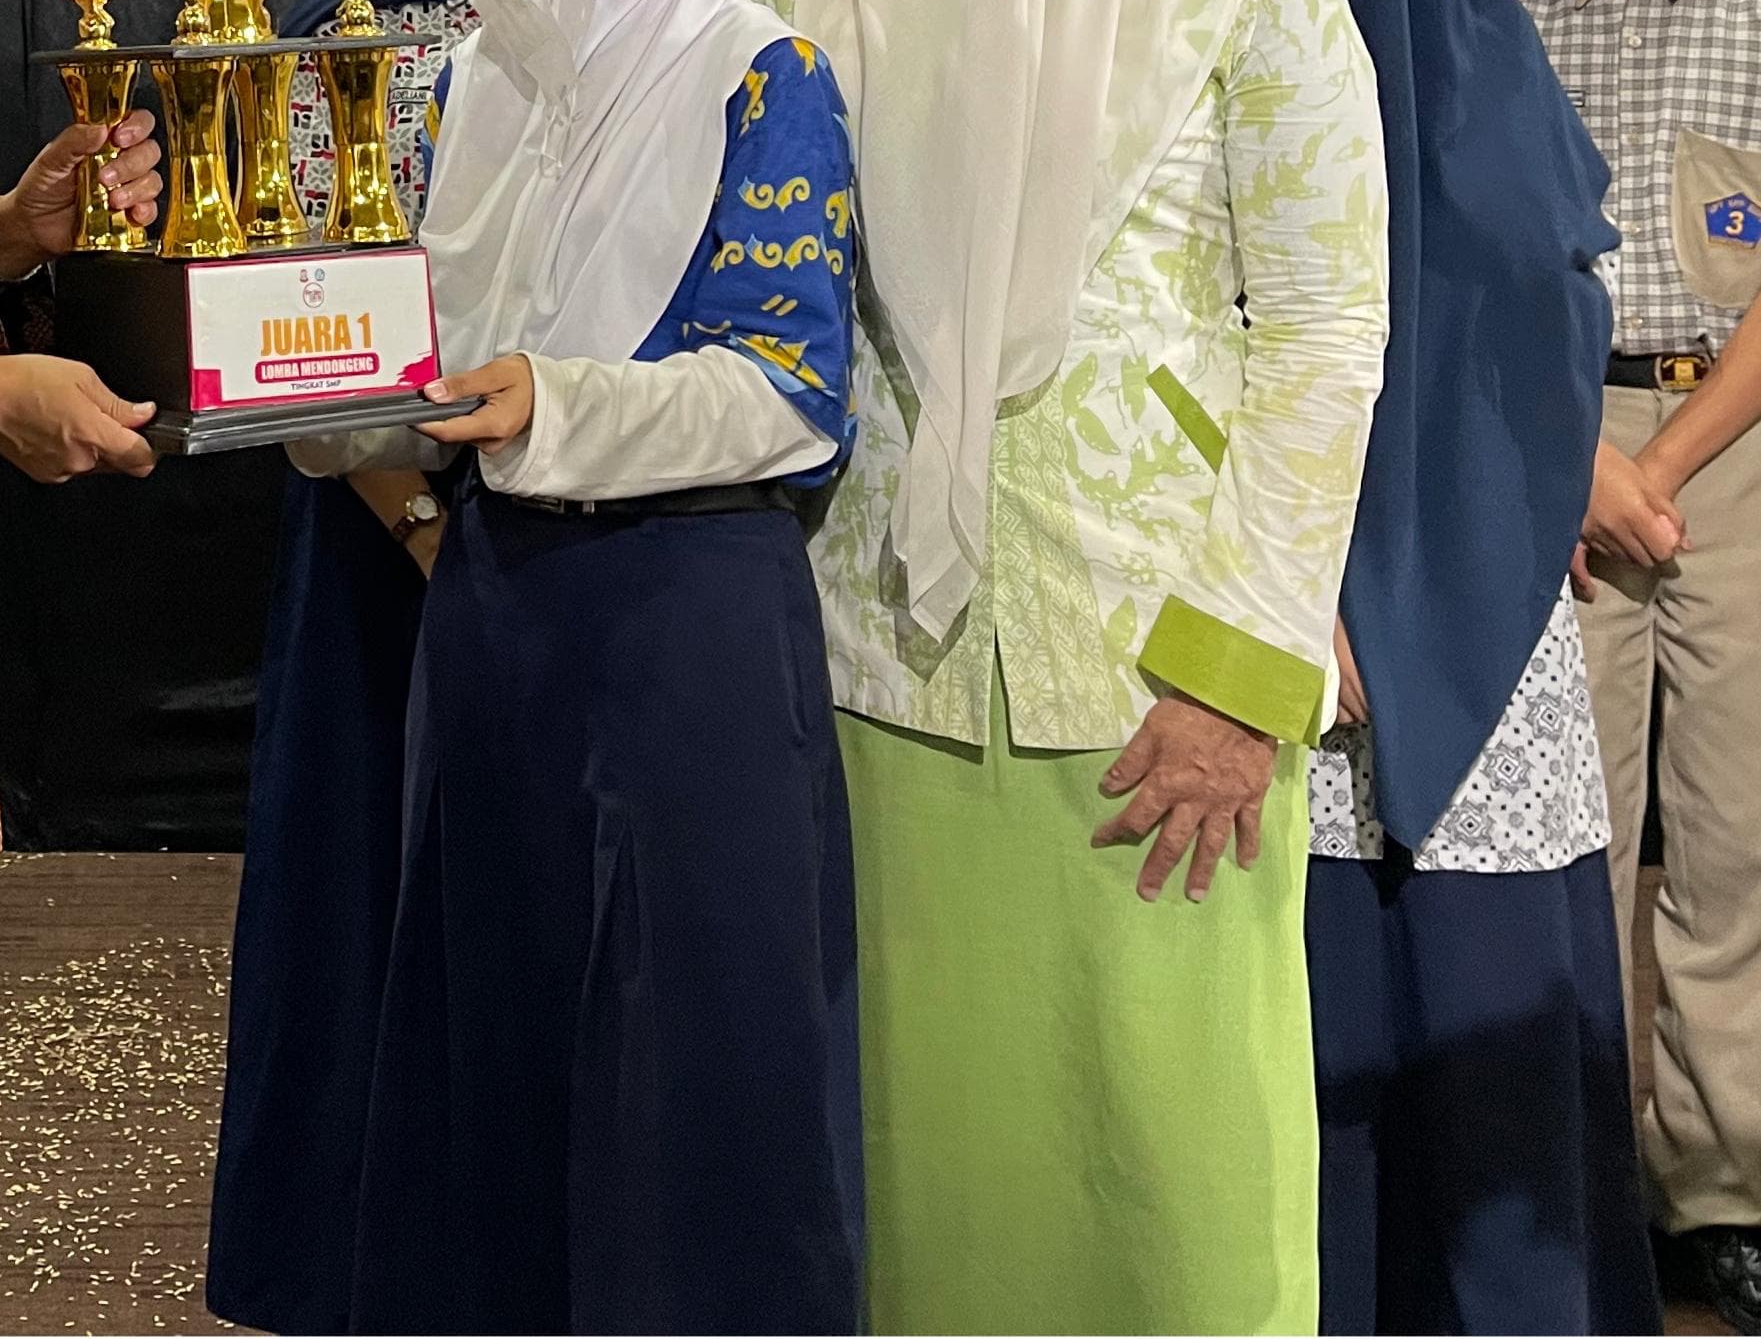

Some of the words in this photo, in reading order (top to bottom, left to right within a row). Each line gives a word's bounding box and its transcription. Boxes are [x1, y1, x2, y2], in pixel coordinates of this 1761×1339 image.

[1725, 210, 1745, 235] 3
[260, 313, 353, 357] JUARA
[356, 312, 372, 349] 1
[260, 362, 300, 380] LOMBA
